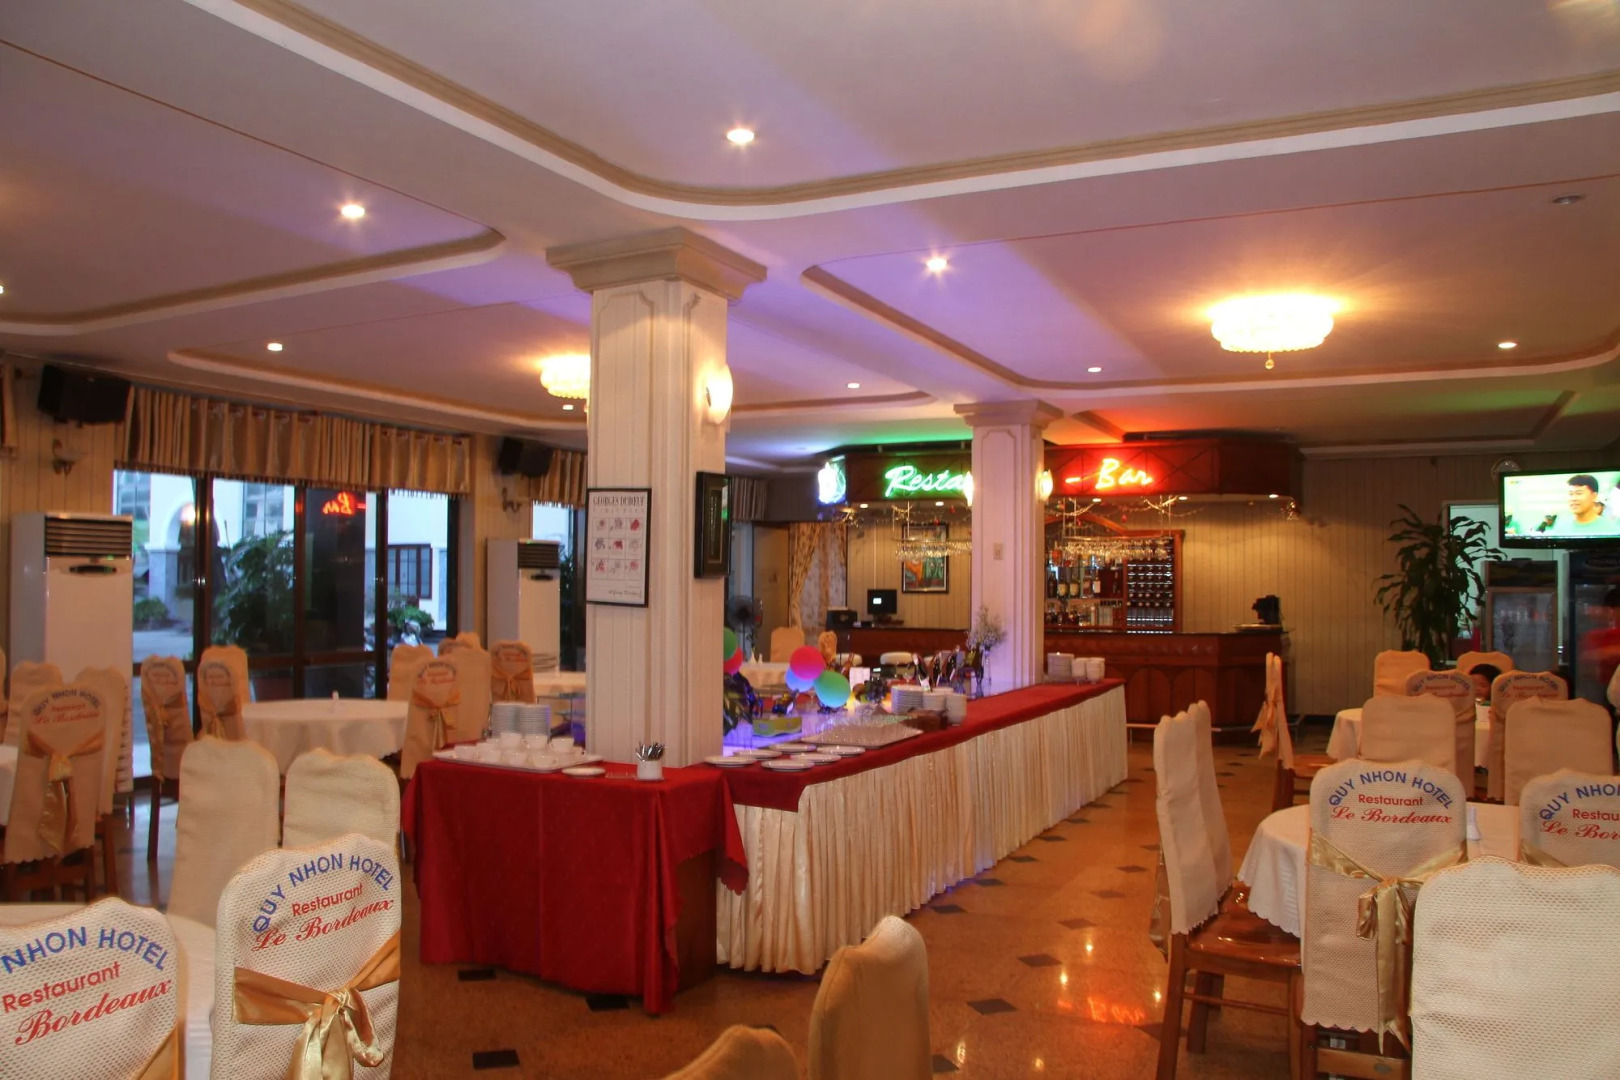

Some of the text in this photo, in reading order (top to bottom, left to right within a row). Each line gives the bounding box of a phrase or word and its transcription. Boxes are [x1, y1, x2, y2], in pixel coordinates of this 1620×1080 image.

[885, 465, 972, 497] Resta
[1095, 458, 1152, 490] Bar
[1329, 770, 1453, 809] QUY NHON HOTEL
[1358, 794, 1424, 807] Restaurant
[1539, 792, 1570, 820] QUY
[1331, 806, 1453, 824] Le Bordeaux
[1541, 820, 1569, 835] Le
[252, 853, 394, 933] QUY NHON HOTEL
[291, 882, 364, 917] Restaurant
[251, 899, 395, 952] Le Bordeaux
[0, 926, 169, 974] NHON HOTEL
[2, 960, 121, 1013] Restaurant
[15, 979, 173, 1046] Bordeaux
